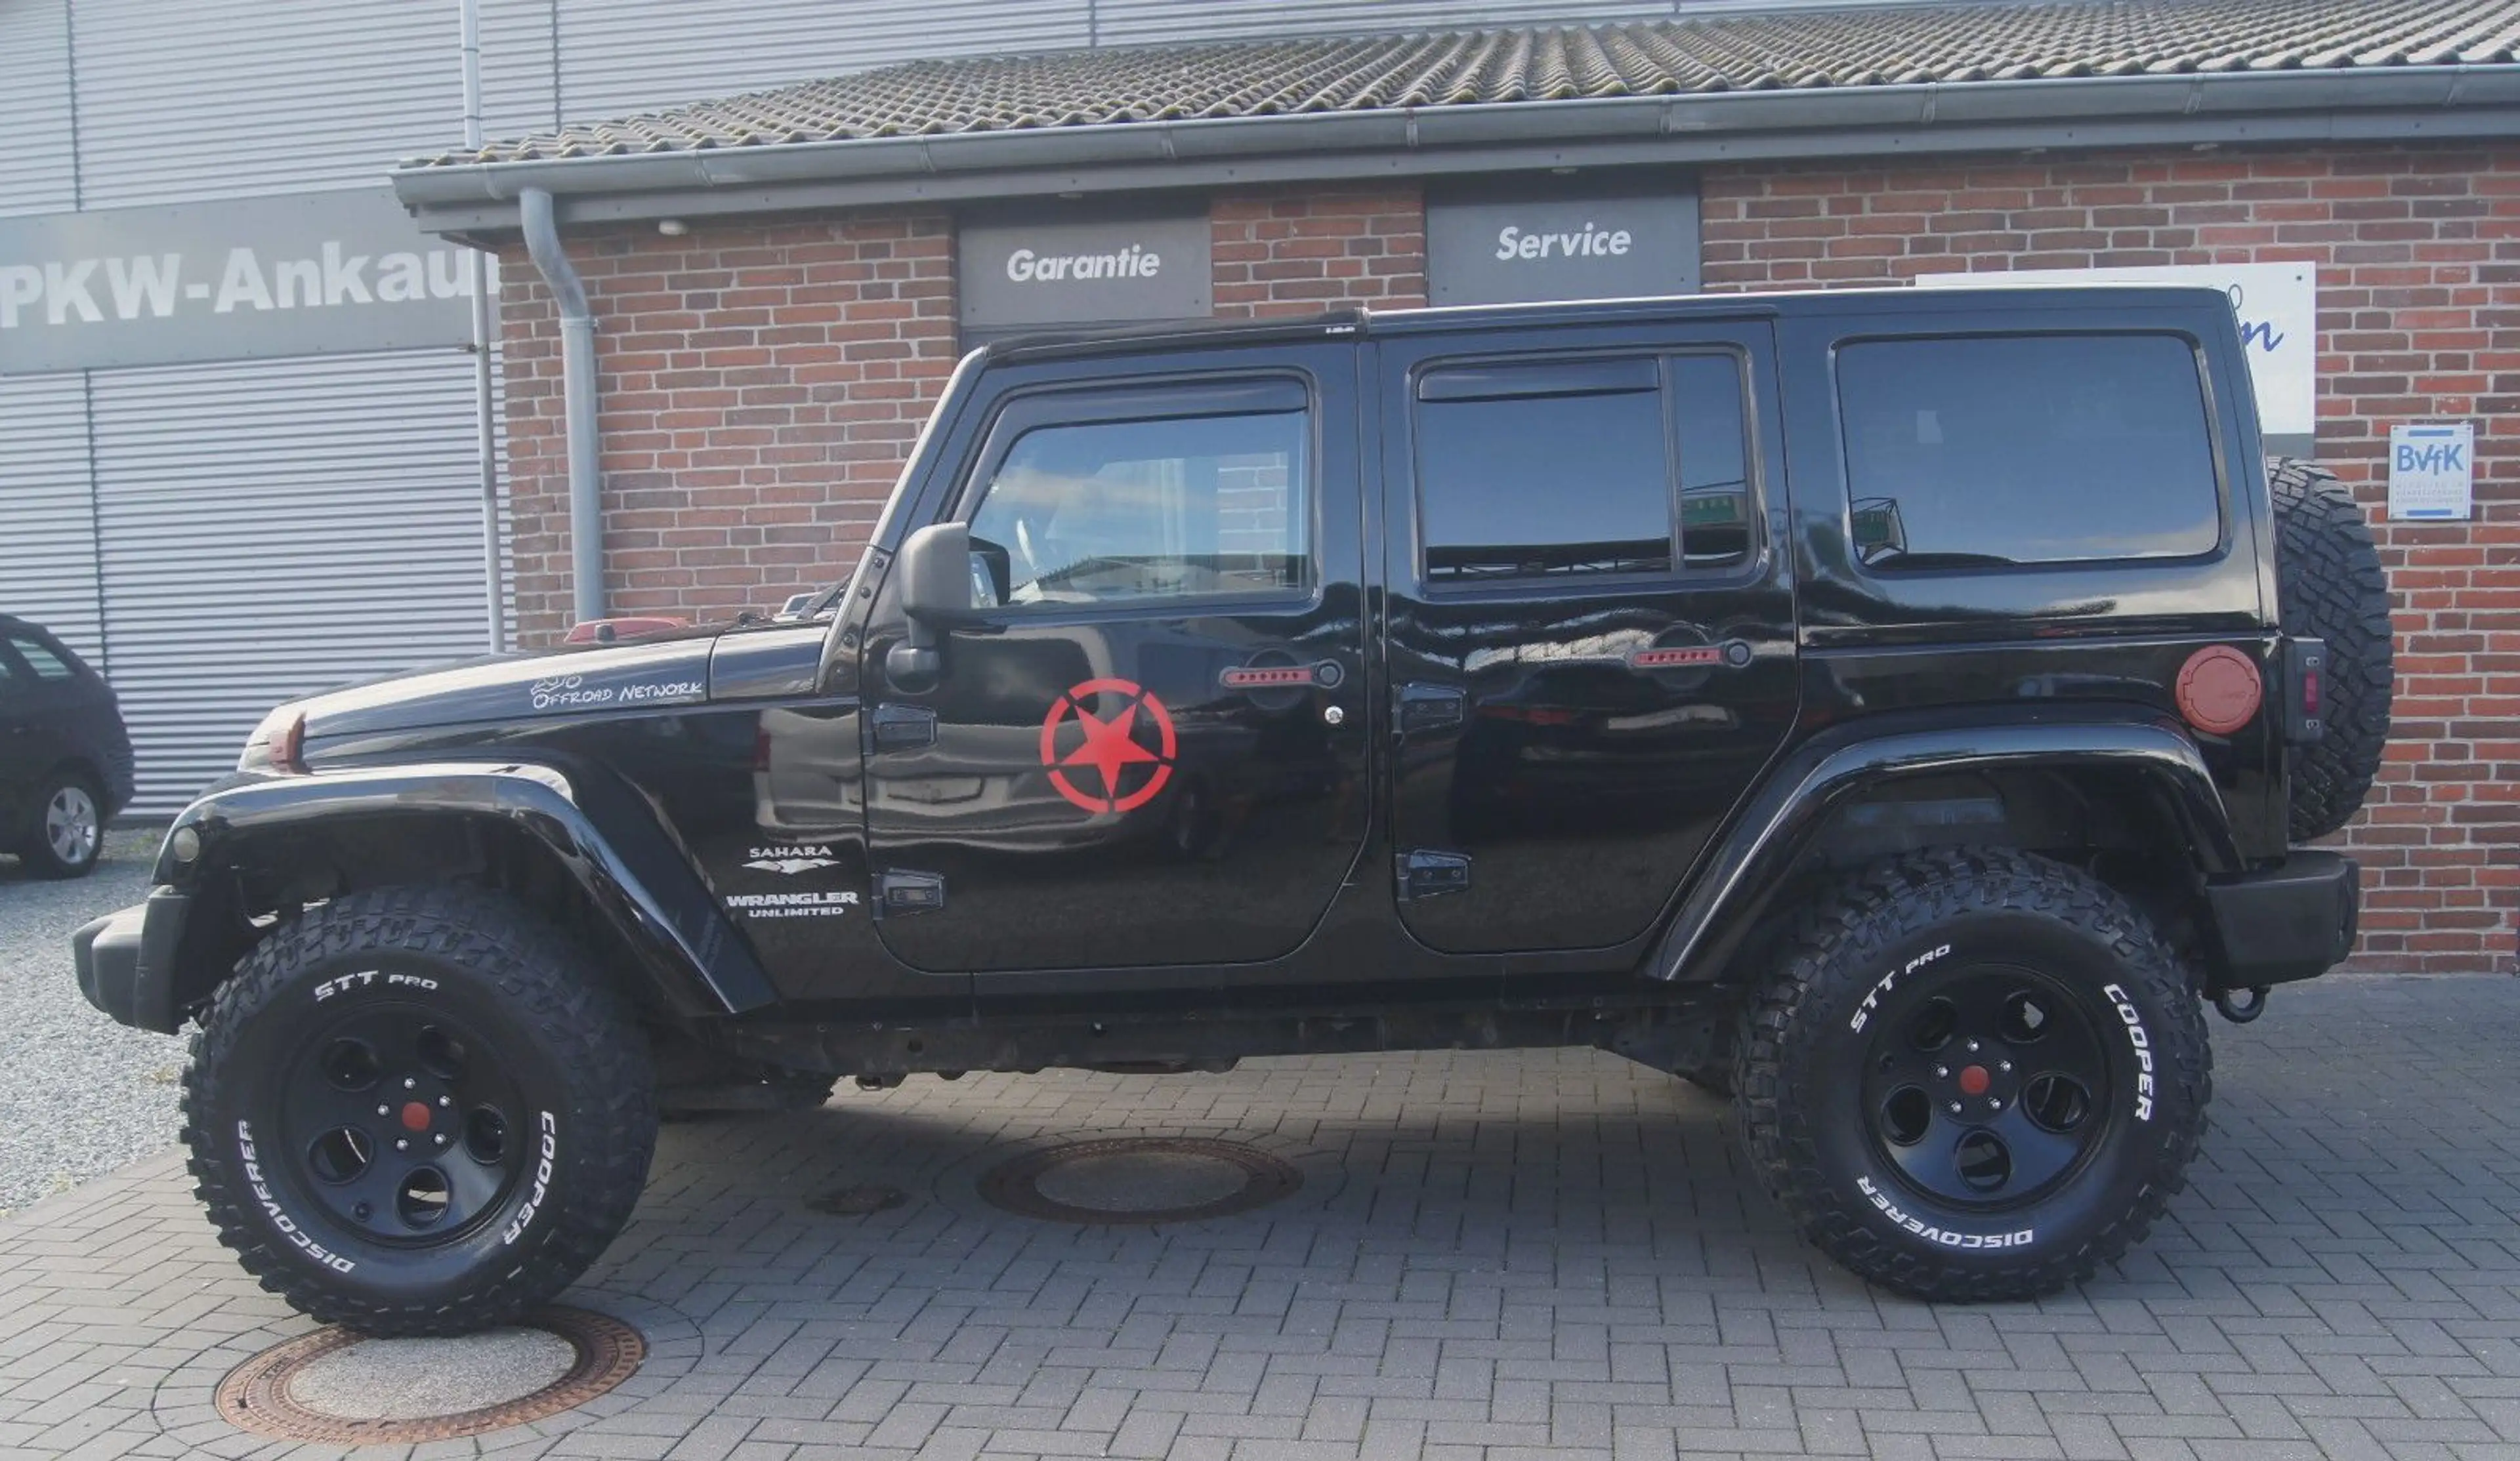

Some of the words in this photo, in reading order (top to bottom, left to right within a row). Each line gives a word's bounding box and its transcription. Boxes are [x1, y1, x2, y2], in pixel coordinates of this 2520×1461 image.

[1495, 222, 1631, 260] Service
[1007, 243, 1160, 282] Garantie
[0, 240, 499, 328] PKW-Ankau
[2397, 443, 2464, 476] BvfK
[749, 845, 833, 858] SAHARA
[726, 891, 860, 907] WRANGLER
[748, 907, 845, 918] UNLIMITED
[314, 970, 379, 1002] STT
[388, 974, 438, 990] PRO
[1850, 970, 1896, 1034] STT
[1905, 944, 1951, 974] PRO
[2103, 983, 2153, 1122] COOPER
[238, 1119, 356, 1273] DISCOVERER
[501, 1110, 556, 1245] COOPER
[1857, 1175, 2033, 1248] DISCOVERER
